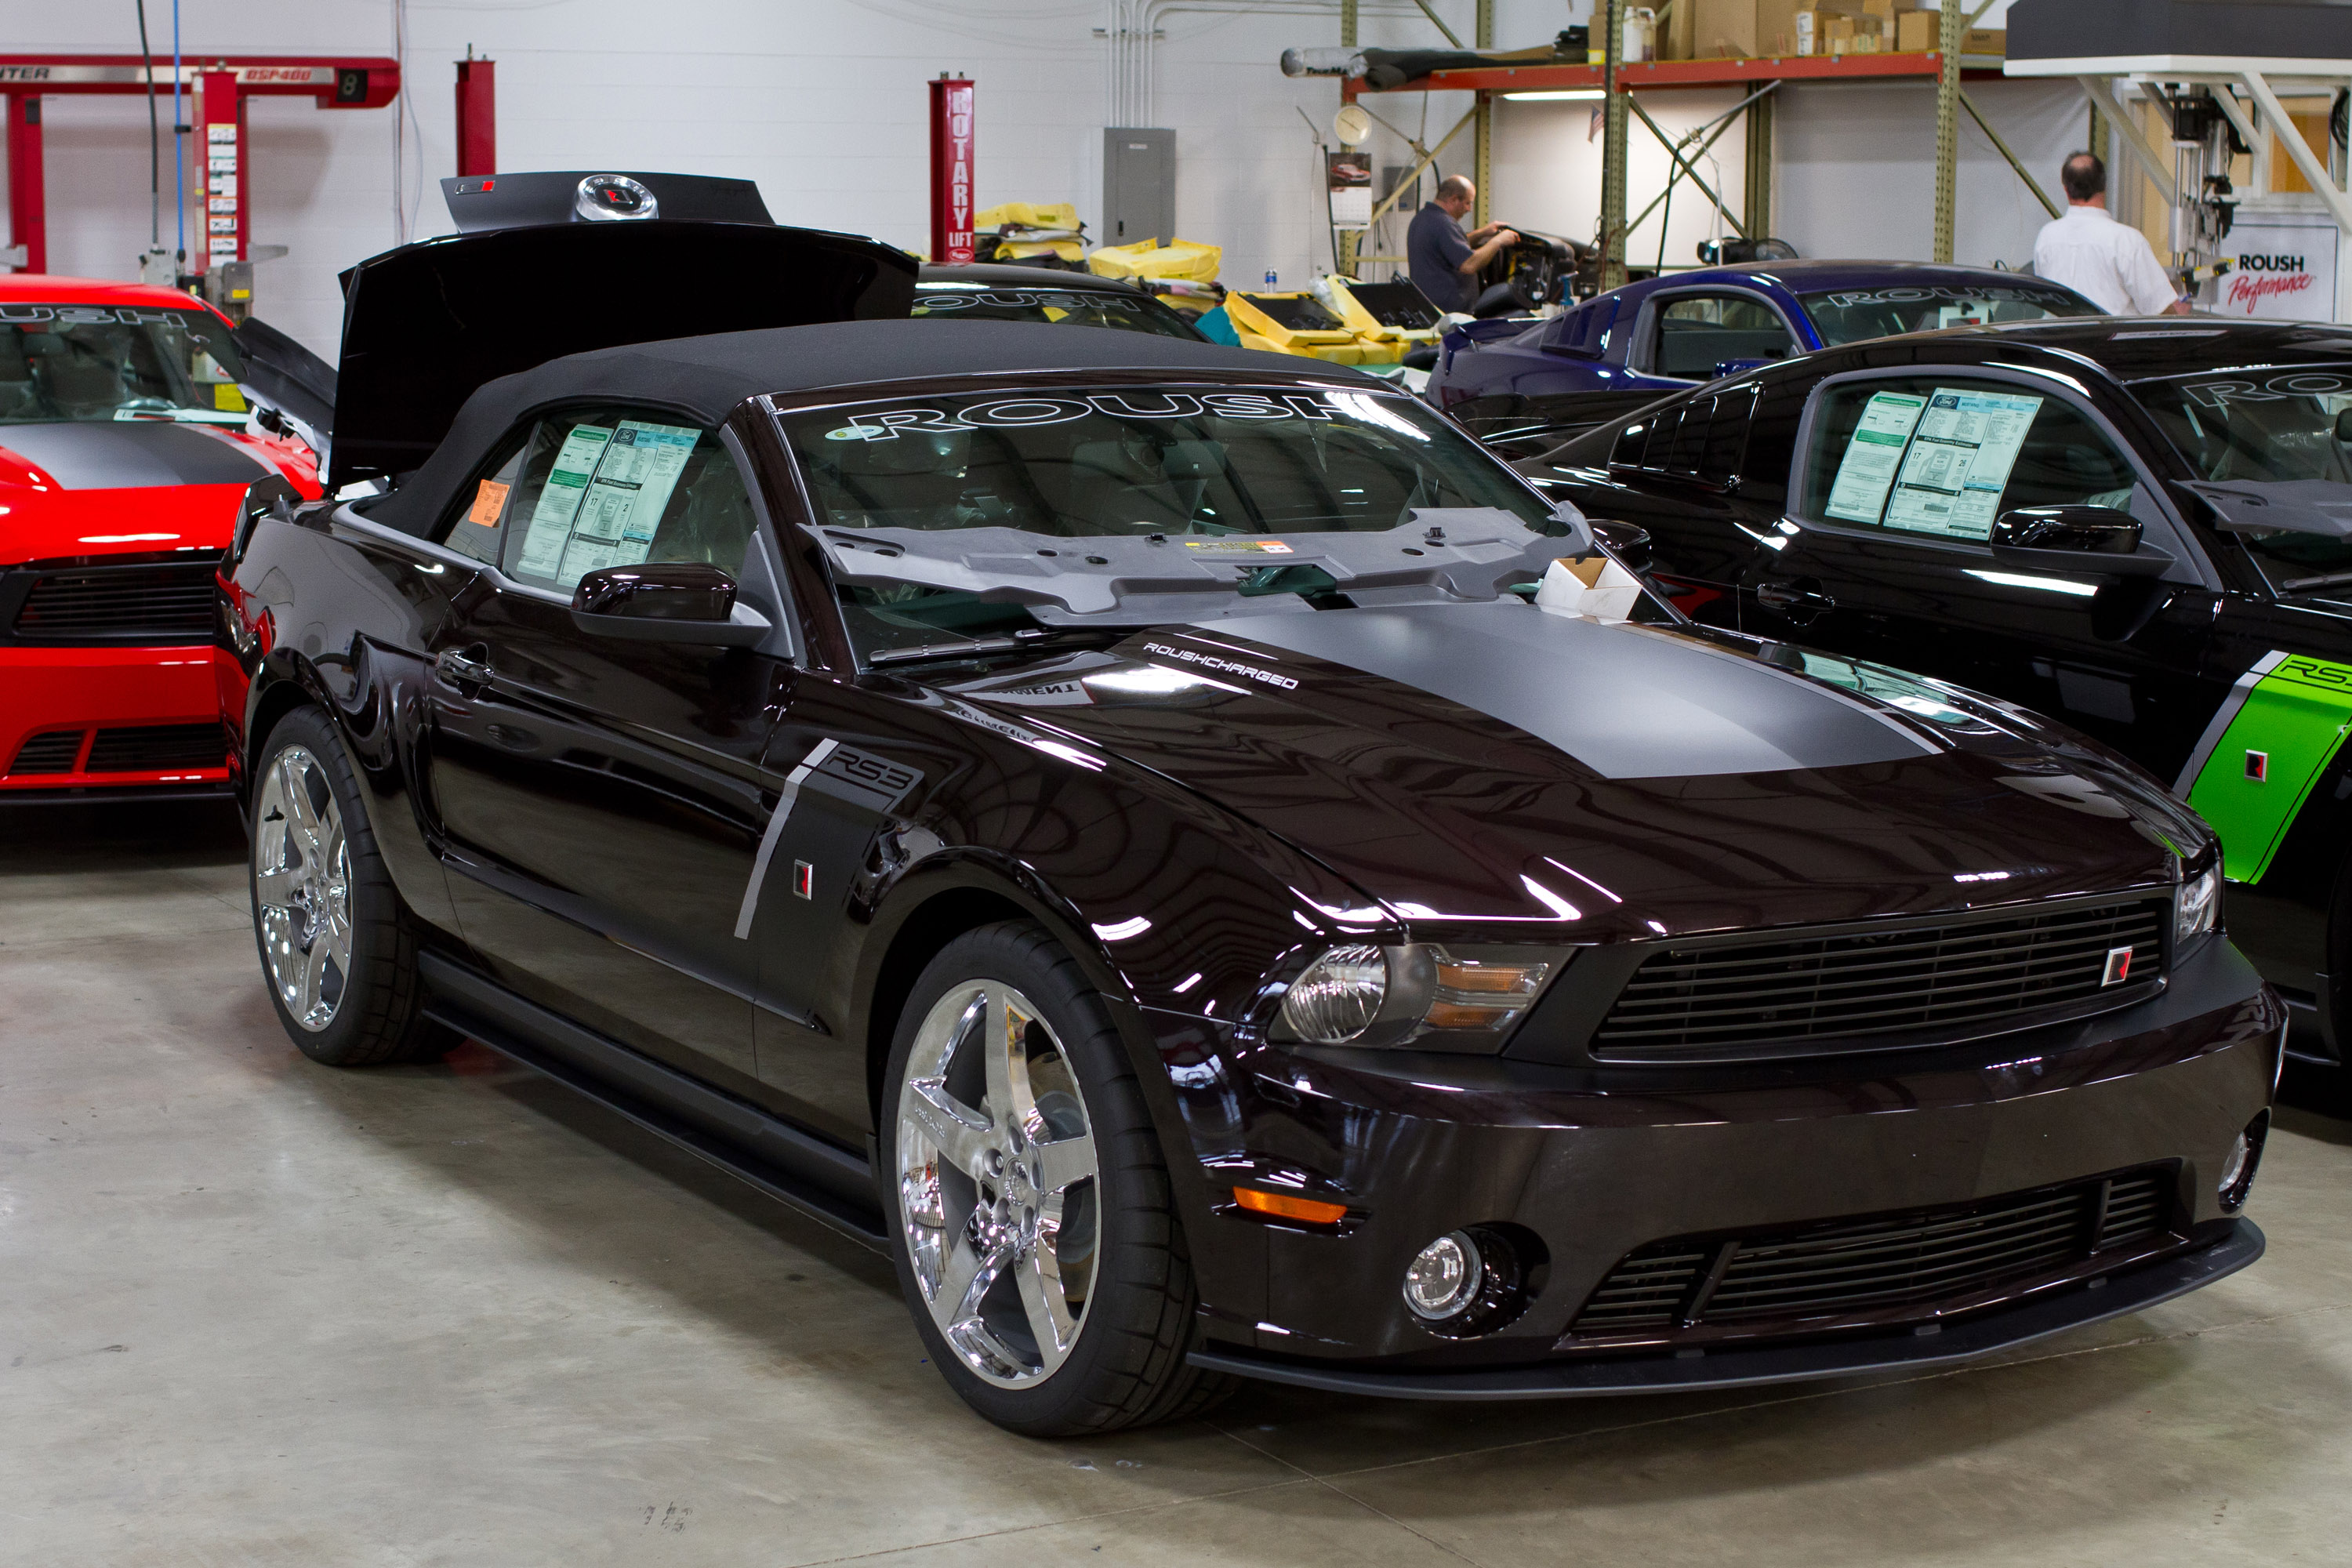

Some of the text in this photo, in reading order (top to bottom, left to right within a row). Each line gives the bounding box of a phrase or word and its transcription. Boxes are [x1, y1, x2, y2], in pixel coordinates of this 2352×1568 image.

[343, 74, 358, 96] 8
[952, 91, 969, 230] ROTARY
[949, 232, 973, 248] LIFT
[2239, 254, 2305, 272] ROUSH
[911, 293, 1142, 312] OUSH
[1828, 287, 2071, 307] ROUSH
[2228, 273, 2313, 314] Performance
[848, 394, 1352, 442] ROUSH
[1143, 642, 1299, 690] ROUSHCHARGED
[2280, 659, 2352, 688] RS
[826, 750, 914, 791] RS3
